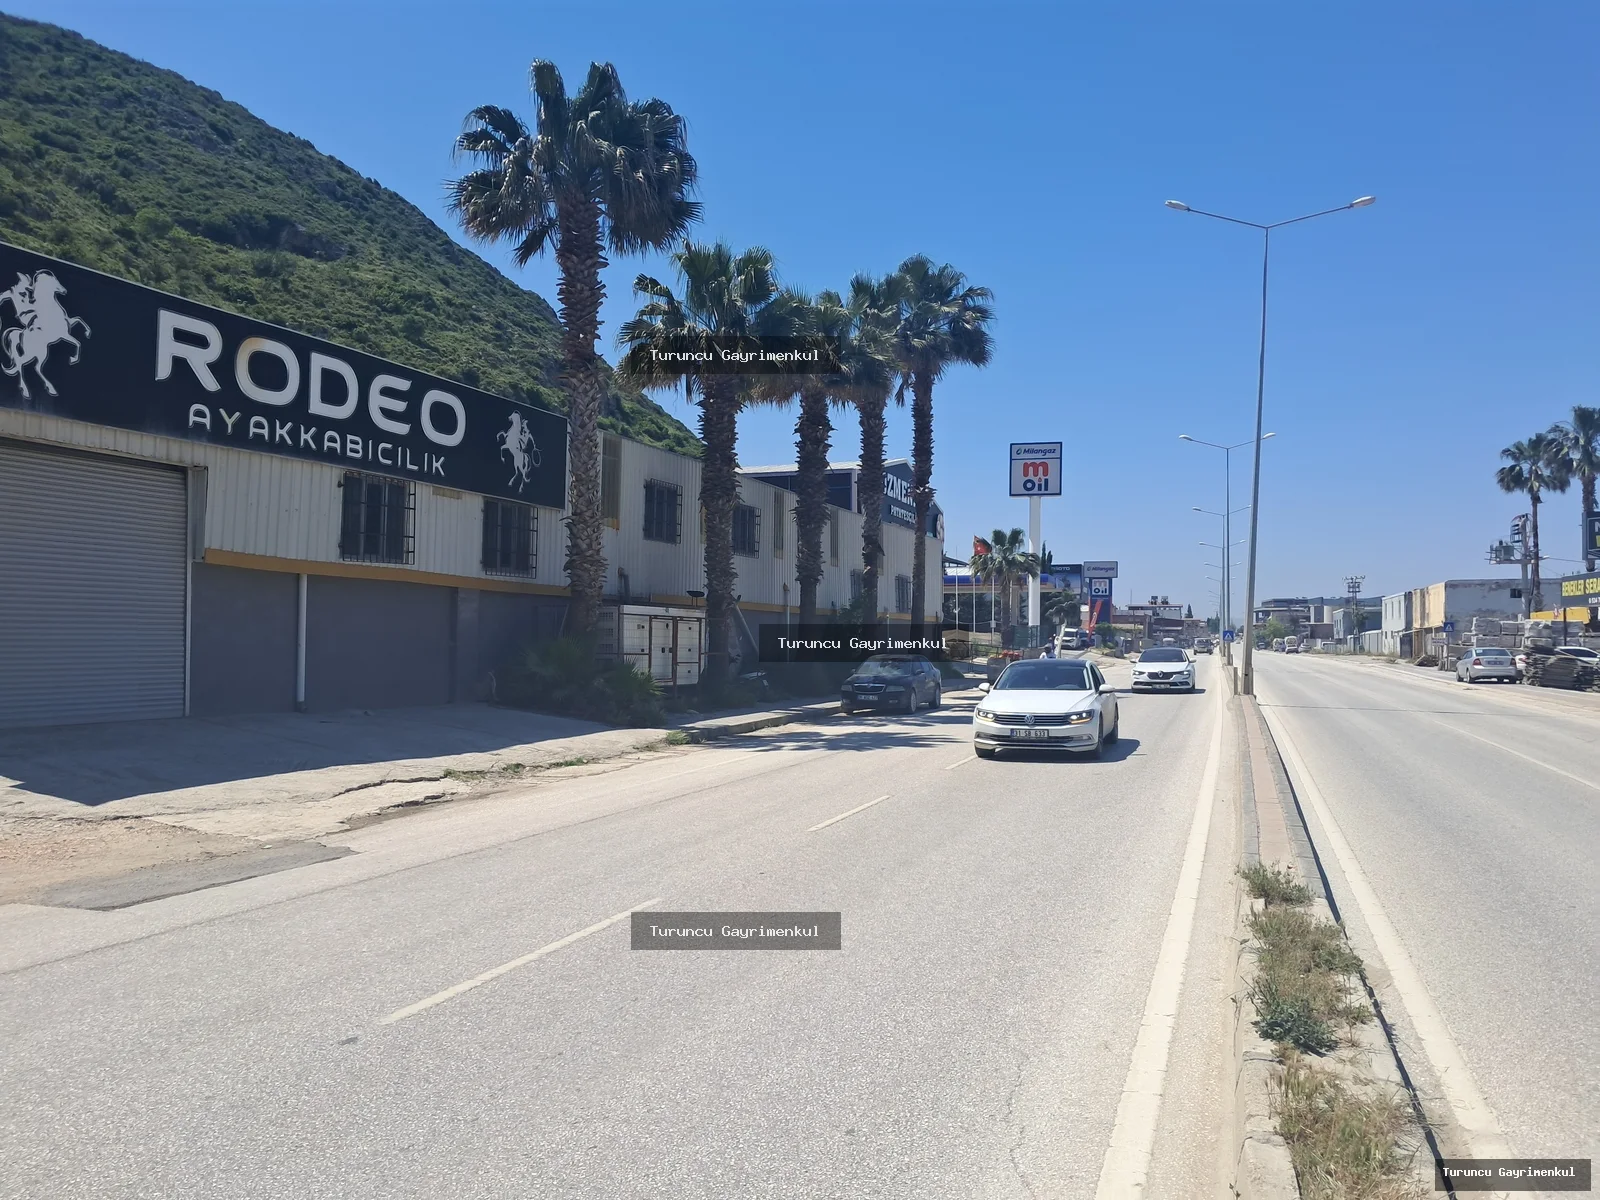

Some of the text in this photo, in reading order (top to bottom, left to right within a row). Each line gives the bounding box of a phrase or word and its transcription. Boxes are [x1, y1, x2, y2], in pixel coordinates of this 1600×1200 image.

[155, 307, 467, 447] RODEO
[188, 403, 446, 477] AYAKKABICILIK
[1023, 447, 1057, 456] Milangaz
[1023, 461, 1049, 477] m
[1023, 477, 1049, 492] oil
